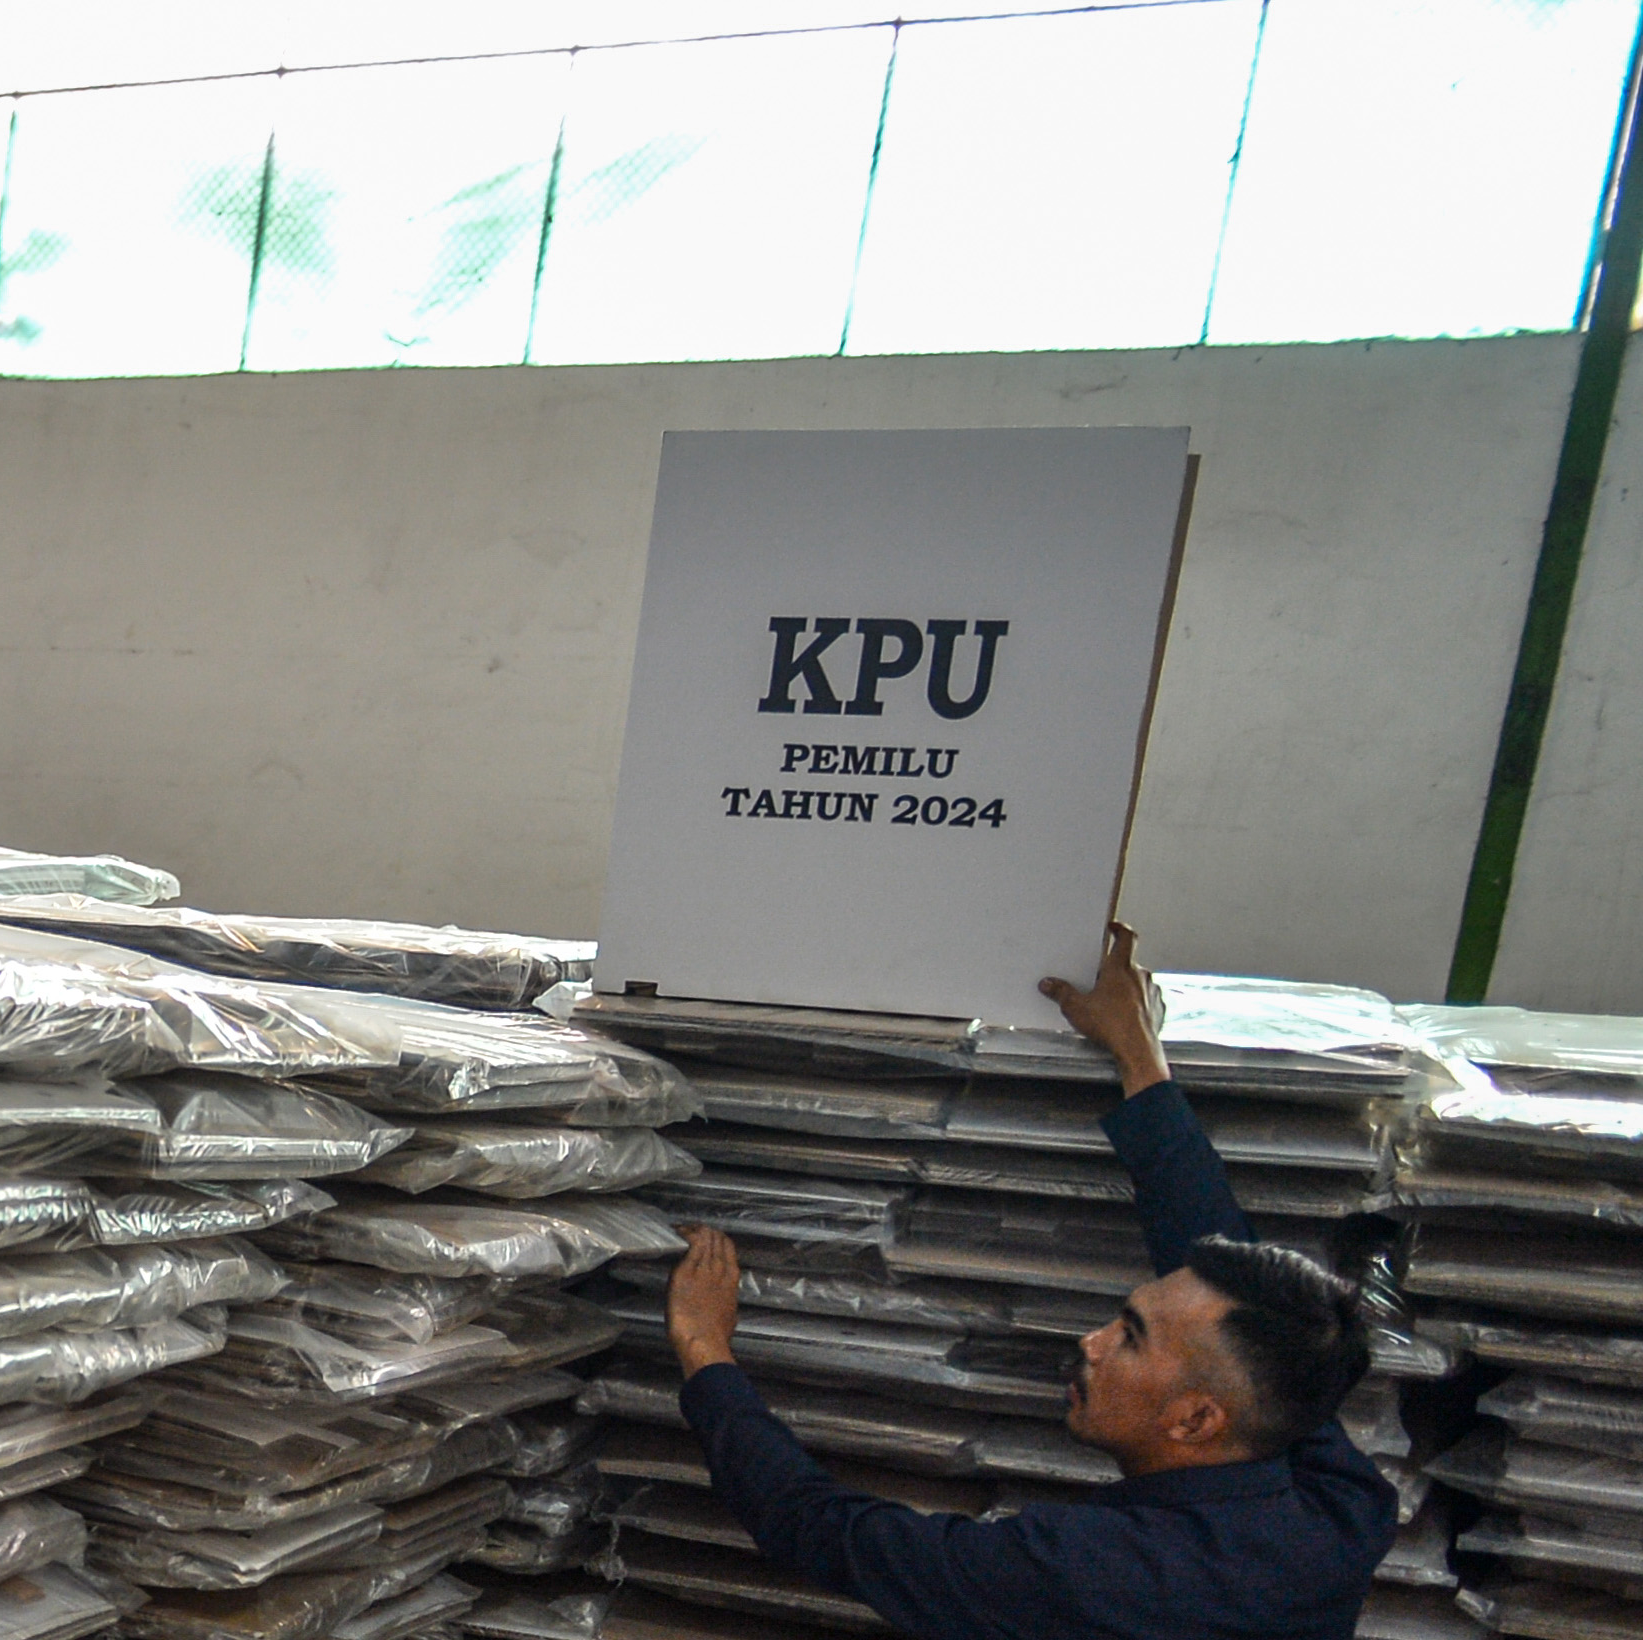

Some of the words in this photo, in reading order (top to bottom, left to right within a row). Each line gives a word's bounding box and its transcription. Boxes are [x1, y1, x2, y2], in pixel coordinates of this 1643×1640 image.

[757, 615, 1010, 721] KPU
[778, 742, 961, 779] PEMILU
[721, 786, 880, 823] TAHUN
[890, 794, 1008, 829] 2024
